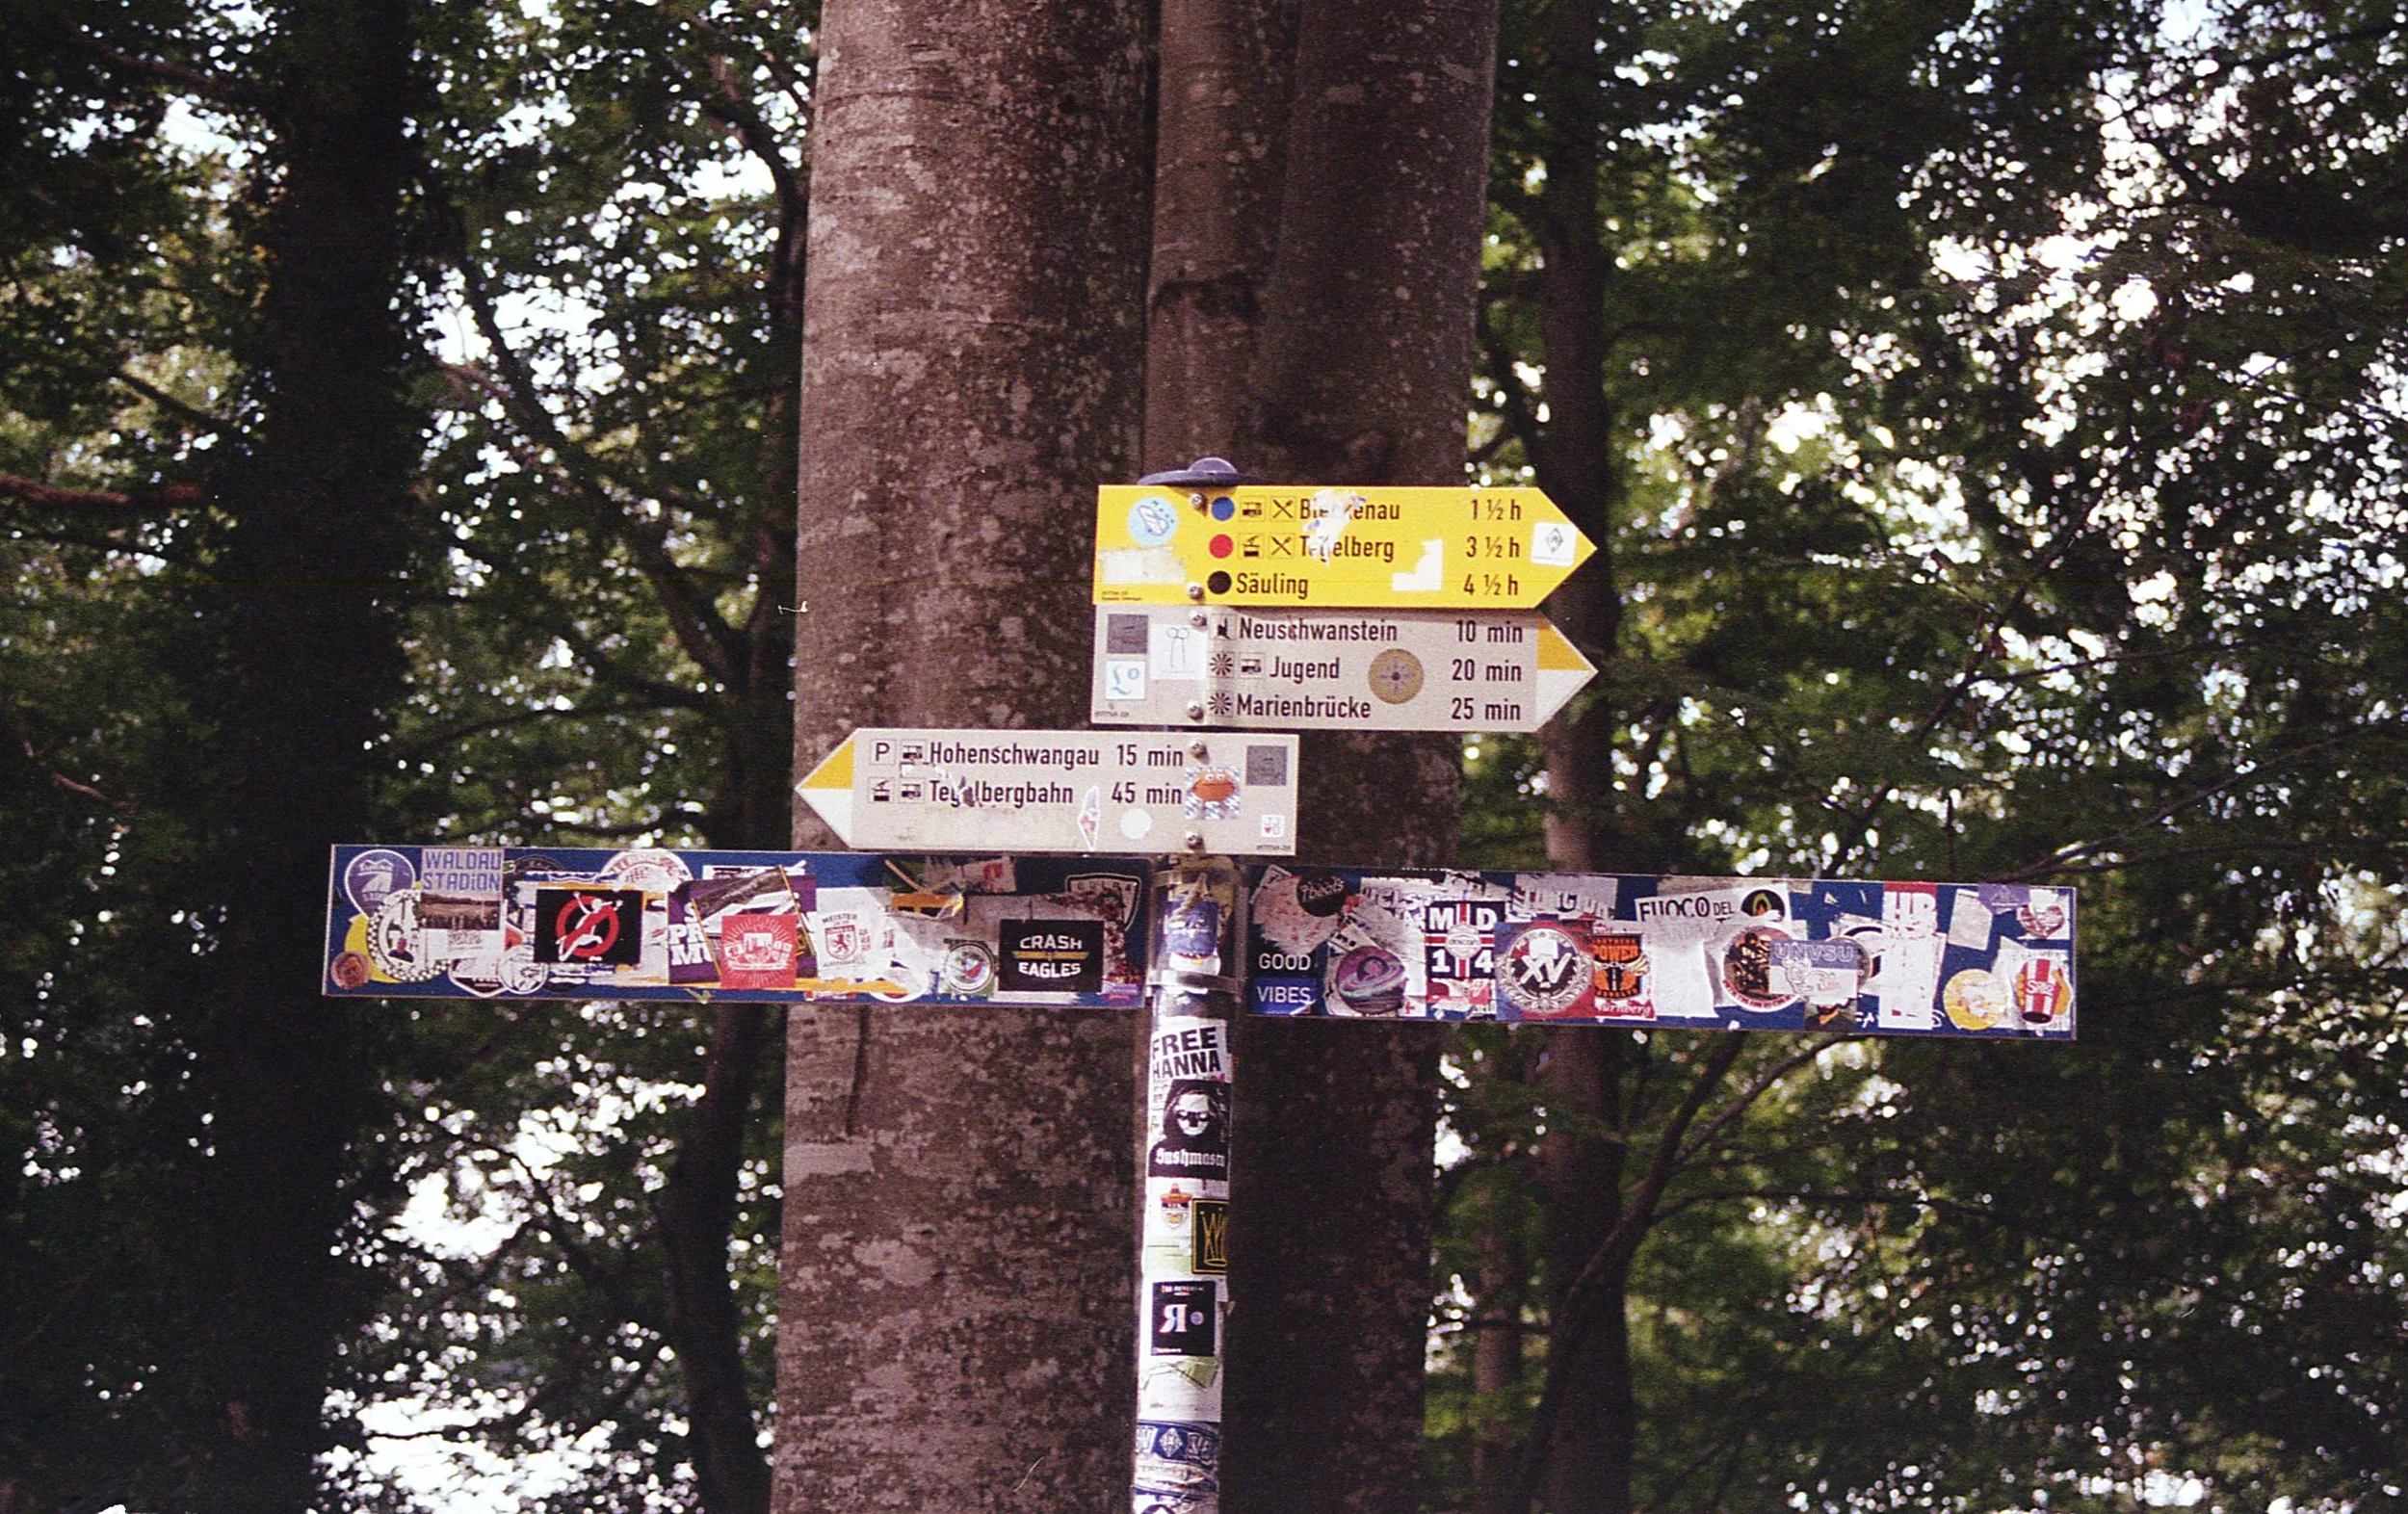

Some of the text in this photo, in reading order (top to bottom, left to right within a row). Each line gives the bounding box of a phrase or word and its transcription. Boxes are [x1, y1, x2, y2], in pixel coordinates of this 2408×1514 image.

[1471, 499, 1479, 520] 1
[1510, 499, 1521, 520] h
[1466, 536, 1477, 558] 3
[1509, 536, 1520, 558] h
[1237, 572, 1308, 599] Säuling
[1464, 574, 1475, 595] 4
[1507, 574, 1518, 595] h
[1239, 618, 1523, 643] Neuschwanstein 10 min
[1269, 656, 1521, 684] Jugend 20 min
[1237, 693, 1520, 720] Marienbrücke 25 min
[876, 742, 1184, 770] P Hohenschwangau 15 min
[1112, 781, 1136, 804] 45
[1146, 782, 1182, 804] min
[424, 850, 501, 871] WALDAU
[822, 912, 858, 924] MEISTER
[1019, 934, 1083, 950] CRASH
[1018, 961, 1082, 979] EAGLES
[1258, 953, 1312, 971] GOOD
[1256, 985, 1312, 1004] VIBES
[1152, 1027, 1217, 1060] FREE
